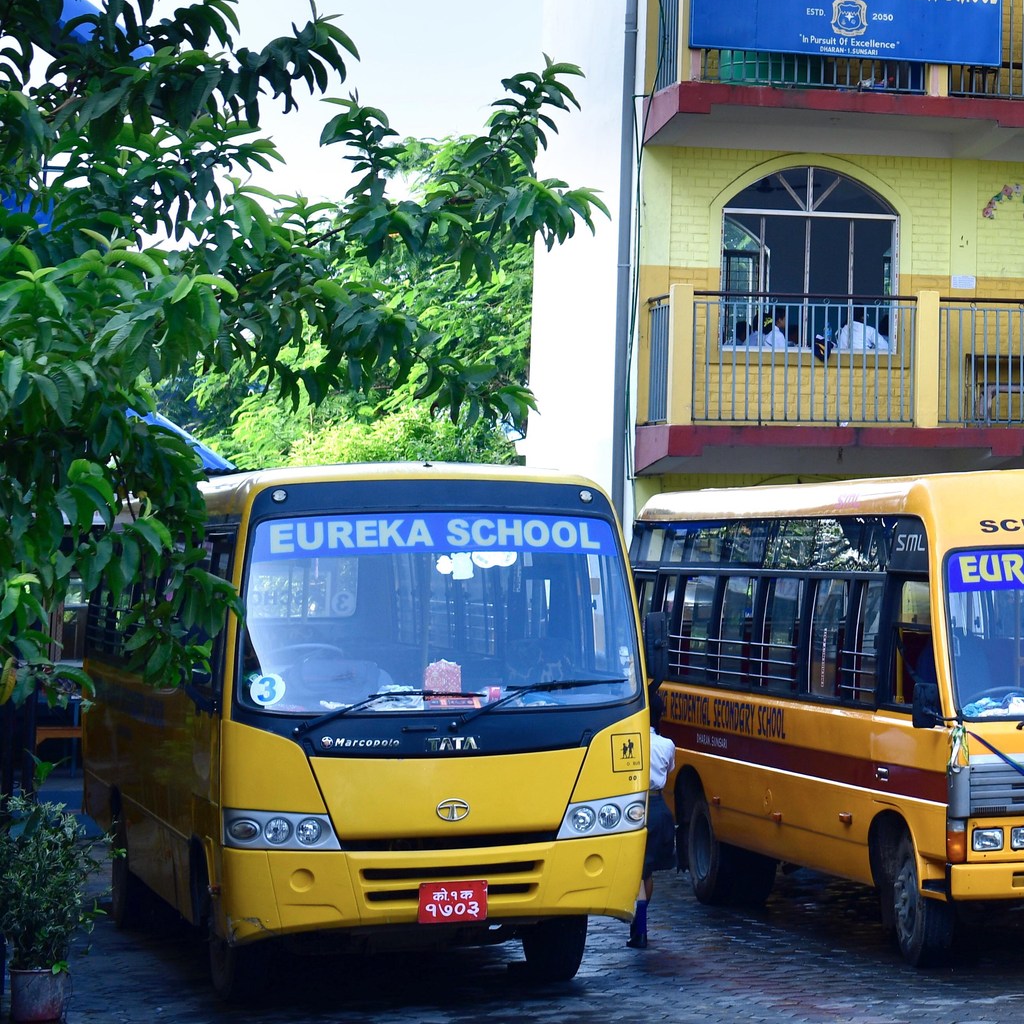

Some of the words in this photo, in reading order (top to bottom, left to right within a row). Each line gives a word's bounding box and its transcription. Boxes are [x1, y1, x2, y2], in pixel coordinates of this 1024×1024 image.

[806, 7, 826, 17] ESTD.
[872, 13, 894, 22] 2050
[810, 35, 836, 46] Pursuit
[839, 37, 848, 46] Of
[269, 519, 434, 554] EUREKA
[446, 518, 600, 551] SCHOOL
[896, 534, 925, 552] SML
[257, 677, 276, 702] 3
[670, 692, 710, 726] RESIDENTIAL
[713, 698, 755, 735] SECONDARY
[757, 705, 786, 739] SCHOOL
[334, 737, 400, 749] Marcopolo
[428, 737, 478, 751] TATA
[425, 901, 480, 918] १७०३
